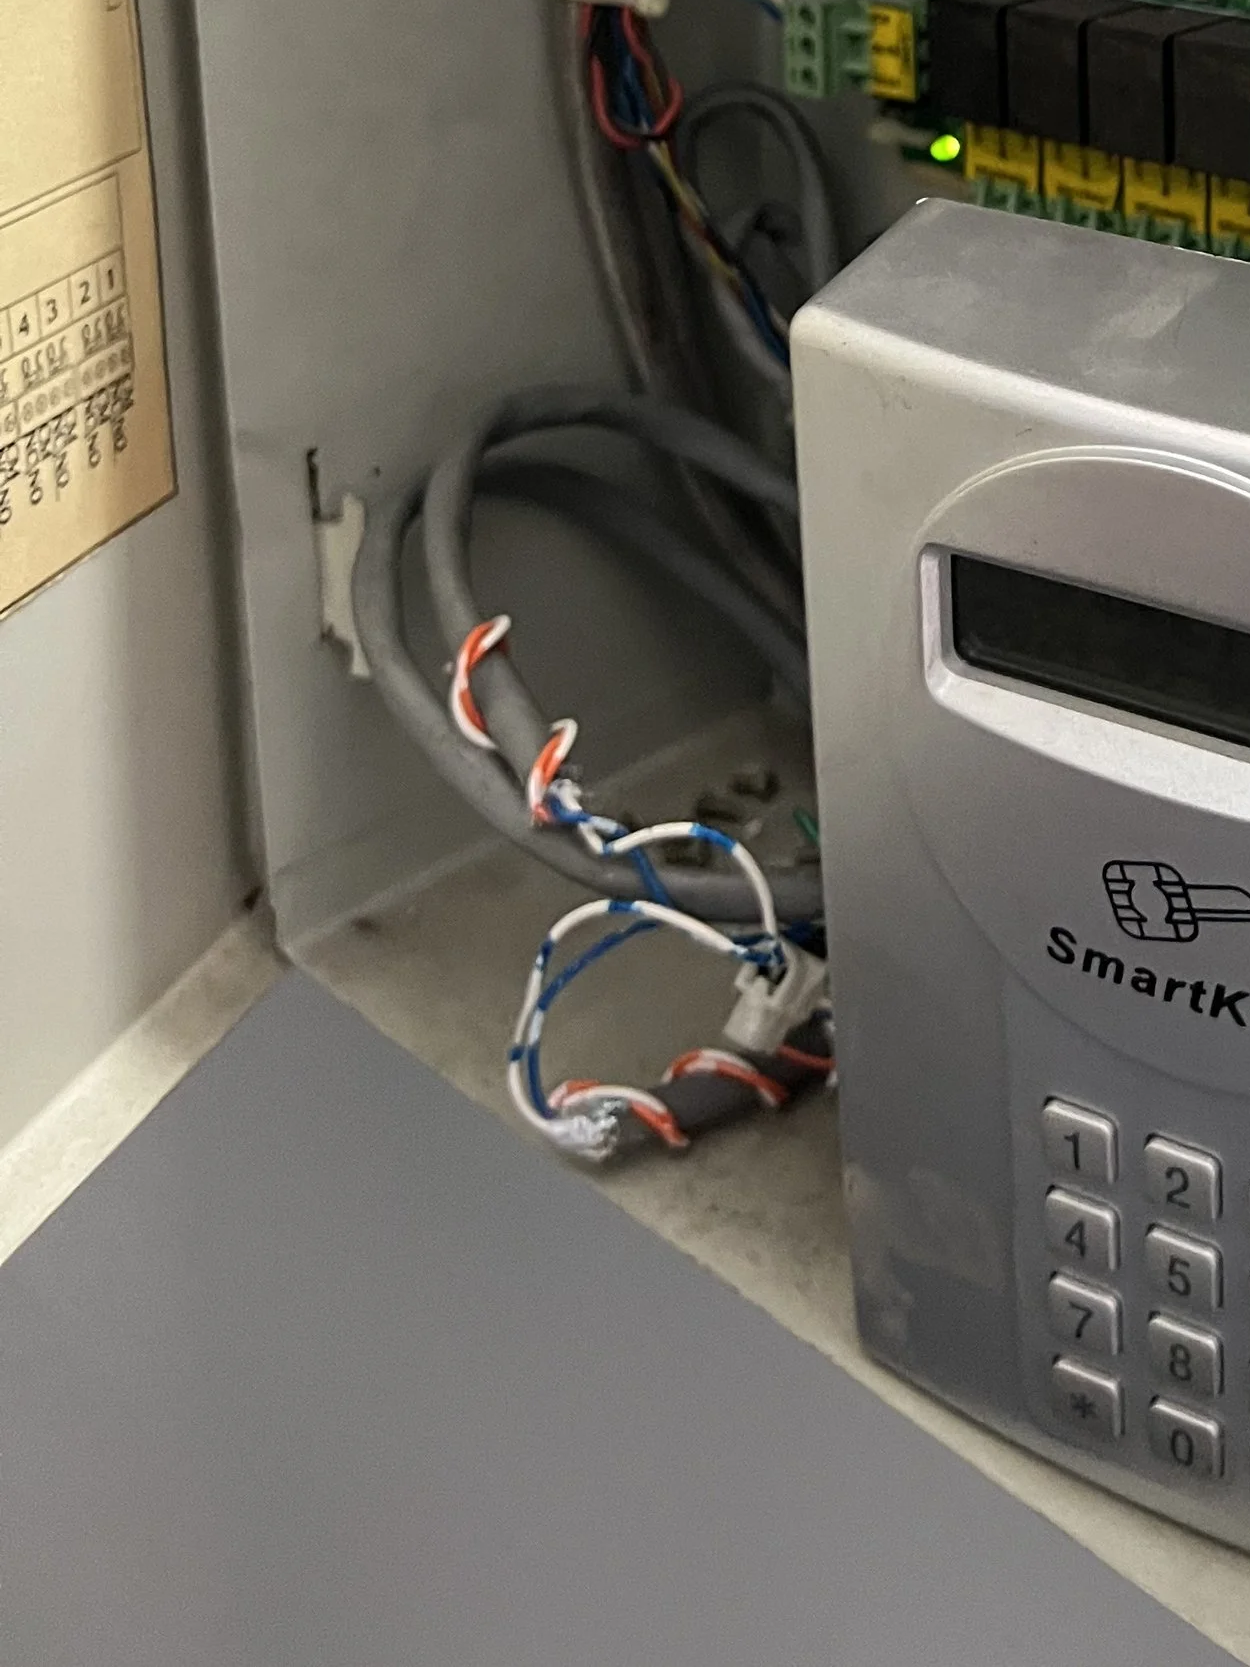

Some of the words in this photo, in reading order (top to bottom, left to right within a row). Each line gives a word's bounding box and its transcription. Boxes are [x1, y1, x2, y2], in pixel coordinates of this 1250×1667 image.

[18, 313, 30, 337] 4
[46, 298, 58, 326] 3
[78, 280, 92, 306] 2
[107, 268, 115, 291] 1
[1063, 1132, 1081, 1170] 1
[1165, 1166, 1191, 1209] 2
[1064, 1220, 1087, 1258] 4
[1168, 1257, 1192, 1297] 5
[1068, 1301, 1093, 1338] 7
[1169, 1343, 1192, 1382] 8
[1171, 1429, 1194, 1466] 0
